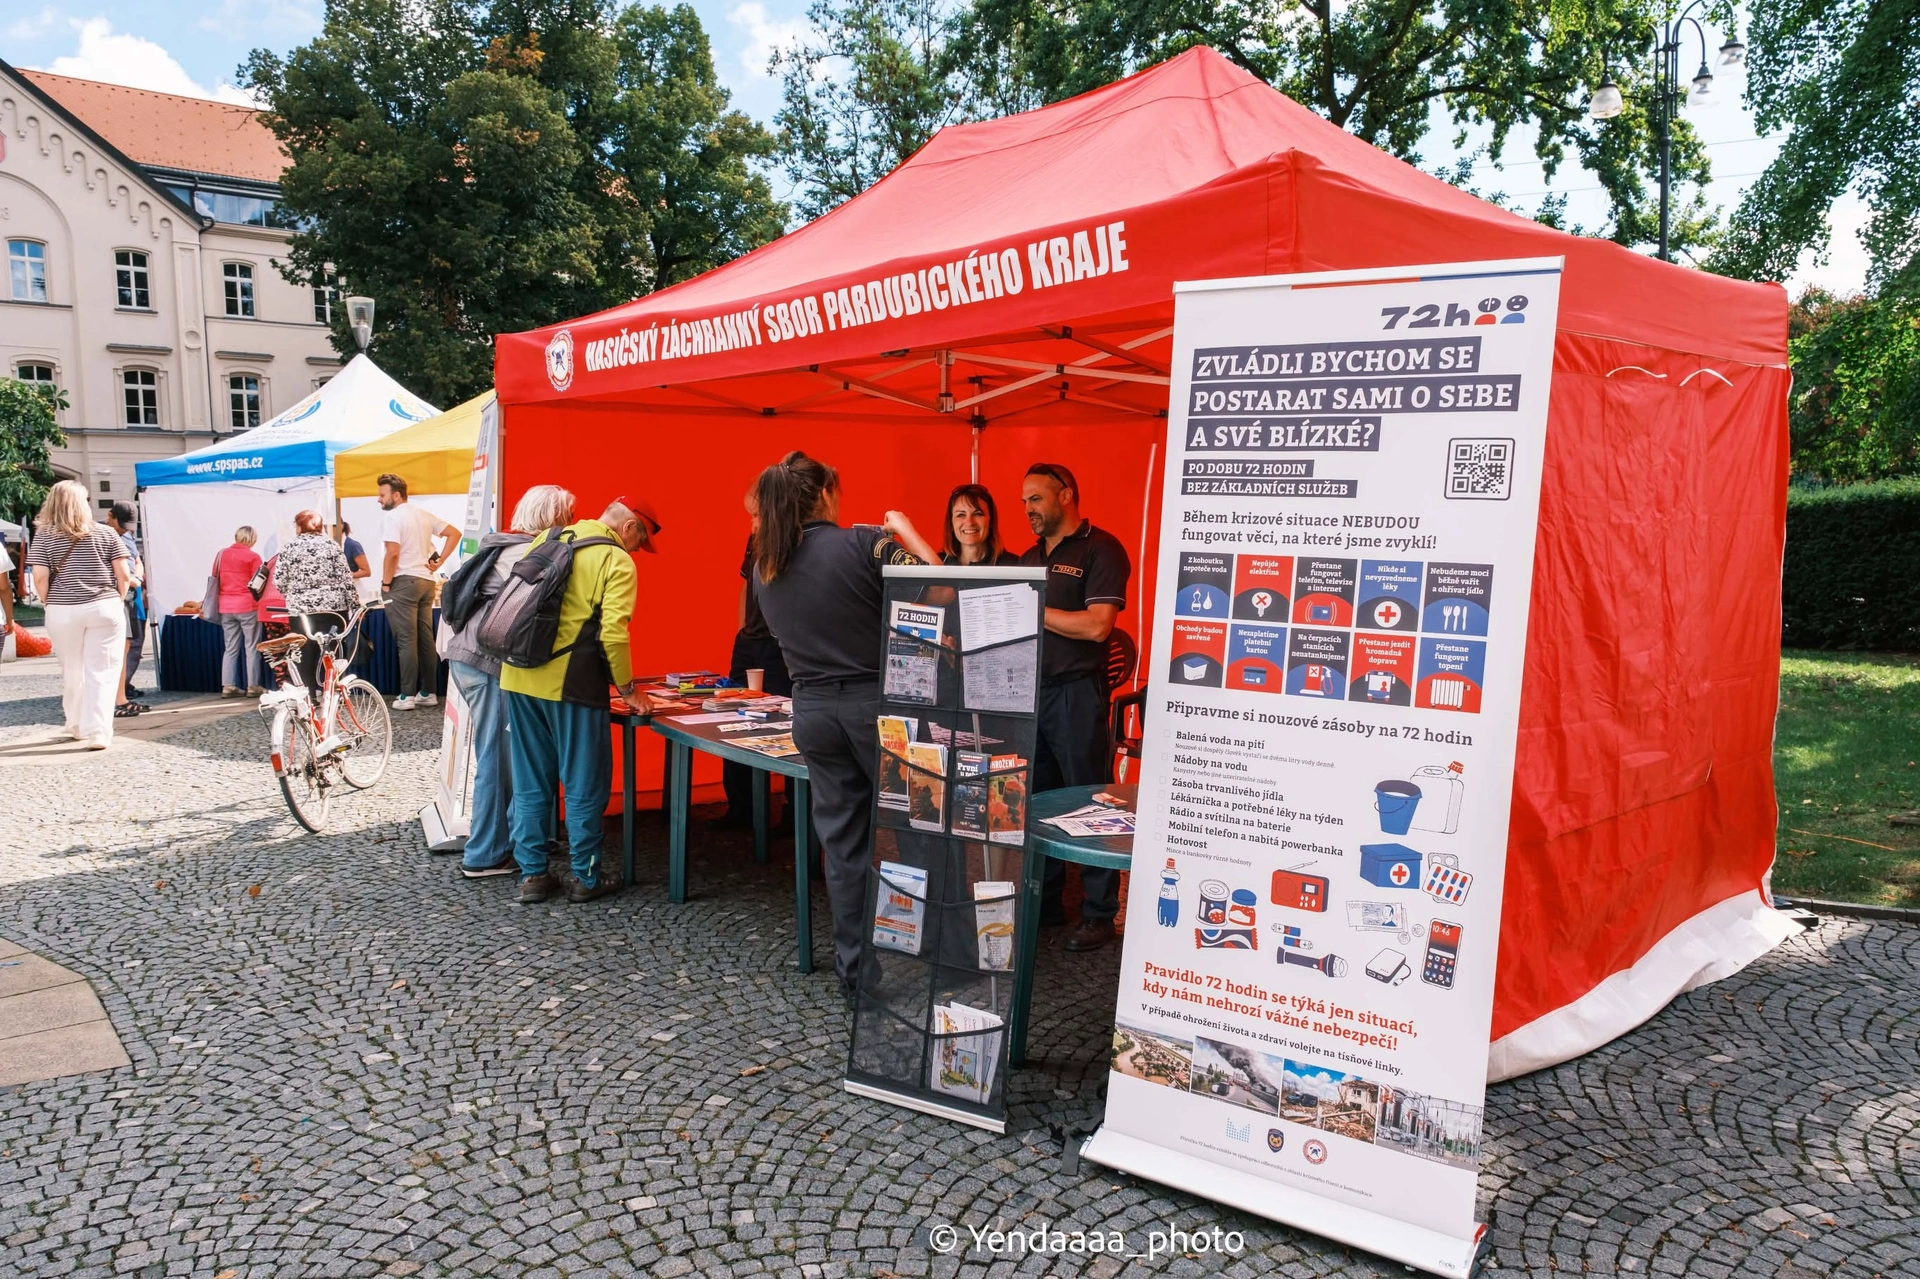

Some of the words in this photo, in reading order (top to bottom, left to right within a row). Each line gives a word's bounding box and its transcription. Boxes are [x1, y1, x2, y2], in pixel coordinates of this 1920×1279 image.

[585, 322, 659, 372] HASIČSKÝ
[660, 303, 762, 361] ZÁCHRANNÝ
[763, 295, 824, 343] SBOR
[822, 249, 1024, 331] PARDUBICKÉHO
[1027, 220, 1129, 290] KRAJE
[1381, 301, 1470, 331] 72h
[1196, 348, 1305, 377] ZVLÁDLI
[1309, 347, 1432, 374] BYCHOM
[1438, 345, 1474, 370] SE
[1193, 388, 1327, 412] POSTARAT
[1332, 386, 1404, 410] SAMI
[1411, 385, 1431, 409] O
[1438, 383, 1513, 408] SEBE
[1189, 426, 1209, 447] A
[1214, 420, 1263, 447] SVÉ
[1268, 419, 1375, 447] BLÍZKÉ?
[186, 456, 264, 475] www.spspas.cz
[1188, 463, 1207, 477] PO
[1205, 463, 1244, 477] DOBU
[1245, 463, 1261, 475] 72
[1262, 463, 1307, 475] HODIN
[1186, 481, 1211, 496] BEZ
[1209, 480, 1296, 496] ZÁKLADNÍCH
[1298, 480, 1348, 496] SLUŽEB
[1182, 509, 1228, 524] Během
[1231, 511, 1284, 526] krizové
[1286, 512, 1339, 527] situace
[1341, 515, 1421, 530] NEBUDOU
[1181, 527, 1243, 545] fungovat
[1246, 529, 1278, 546] věci,
[1281, 534, 1300, 545] na
[1302, 531, 1343, 546] které
[1344, 533, 1382, 551] jsme
[1385, 534, 1437, 553] zvyklí!
[1187, 556, 1193, 564] Z
[1192, 556, 1224, 565] kohoutku
[1251, 560, 1279, 569] Nepůjde
[1311, 561, 1342, 571] Přestane
[1183, 565, 1212, 573] nepoteče
[1211, 566, 1228, 574] voda
[1249, 567, 1280, 576] elektřina
[1310, 568, 1342, 580] fungovat
[1377, 565, 1399, 573] Nikde
[1399, 566, 1406, 574] si
[1430, 567, 1470, 576] Nebudeme
[1470, 569, 1490, 579] moci
[1298, 576, 1326, 586] telefon,
[1303, 579, 1353, 588] televize
[1364, 574, 1418, 584] nevyzvedneme
[1438, 576, 1460, 585] běžně
[1460, 577, 1480, 586] vařit
[1312, 583, 1342, 593] internet
[1382, 582, 1399, 592] léky
[1437, 585, 1466, 594] ohřívat
[1465, 586, 1484, 596] jídlo
[899, 611, 909, 620] 72
[910, 612, 938, 625] HODIN
[1175, 624, 1203, 634] Obchody
[1203, 626, 1224, 635] budou
[1237, 629, 1279, 639] Nezaplatíme
[1185, 633, 1211, 642] zavřené
[1243, 637, 1272, 648] platební
[1297, 633, 1308, 641] Na
[1308, 633, 1342, 644] čerpacích
[1302, 643, 1335, 653] stanicích
[1358, 638, 1390, 647] Přestane
[1390, 640, 1411, 649] jezdit
[1435, 643, 1469, 653] Přestane
[1245, 646, 1268, 655] kartou
[1365, 647, 1402, 657] hromadná
[1291, 651, 1346, 662] nenatankujeme
[1368, 656, 1398, 666] doprava
[1434, 652, 1469, 663] fungovat
[1438, 662, 1464, 672] topení
[1166, 700, 1240, 720] Připravme
[1242, 708, 1255, 722] si
[1258, 713, 1319, 729] nouzové
[1321, 717, 1376, 738] zásoby
[1378, 726, 1399, 738] na
[1402, 726, 1420, 741] 72
[1423, 727, 1473, 747] hodin
[1176, 730, 1207, 743] Balená
[1209, 735, 1232, 746] voda
[1233, 739, 1246, 748] na
[1247, 739, 1265, 750] pití
[957, 762, 978, 773] První
[1173, 754, 1210, 769] Nádoby
[1210, 760, 1223, 769] na
[1224, 761, 1248, 772] vodu
[1171, 777, 1204, 791] Zásoba
[1205, 783, 1261, 799] trvanlivého
[1261, 789, 1284, 802] jídla
[1170, 791, 1222, 808] Lékárnička
[1223, 801, 1230, 809] a
[1231, 802, 1275, 816] potřebné
[1276, 806, 1298, 821] léky
[1299, 812, 1312, 822] na
[1314, 813, 1344, 826] týden
[1169, 806, 1196, 818] Rádio
[1196, 812, 1203, 820] a
[1204, 812, 1241, 825] svítilna
[1242, 819, 1255, 828] na
[1257, 818, 1292, 833] baterie
[1167, 834, 1208, 850] Hotovost
[1168, 820, 1204, 834] Mobilní
[1205, 826, 1239, 840] telefon
[1240, 833, 1247, 841] a
[1248, 834, 1280, 847] nabitá
[1281, 840, 1343, 857] powerbanka
[1432, 925, 1450, 936] 10:46
[1144, 961, 1203, 986] Pravidlo
[1206, 975, 1222, 991] 72
[1225, 978, 1268, 1001] hodin
[1271, 993, 1288, 1006] se
[1290, 995, 1326, 1015] týká
[1328, 1002, 1355, 1021] jen
[1358, 1010, 1418, 1038] situací,
[1142, 978, 1169, 999] kdy
[1171, 987, 1203, 1005] nám
[1206, 996, 1263, 1019] nehrozí
[1265, 1009, 1309, 1030] vážné
[1312, 1021, 1398, 1052] nebezpečí!
[1141, 1003, 1148, 1012] V
[1148, 1005, 1182, 1020] případě
[1182, 1014, 1222, 1030] ohrožení
[1222, 1022, 1250, 1037] života
[1251, 1031, 1257, 1039] a
[1258, 1033, 1288, 1047] zdraví
[1289, 1041, 1322, 1055] volejte
[1323, 1049, 1336, 1058] na
[1338, 1051, 1373, 1068] tísňové
[1375, 1060, 1403, 1076] linky.
